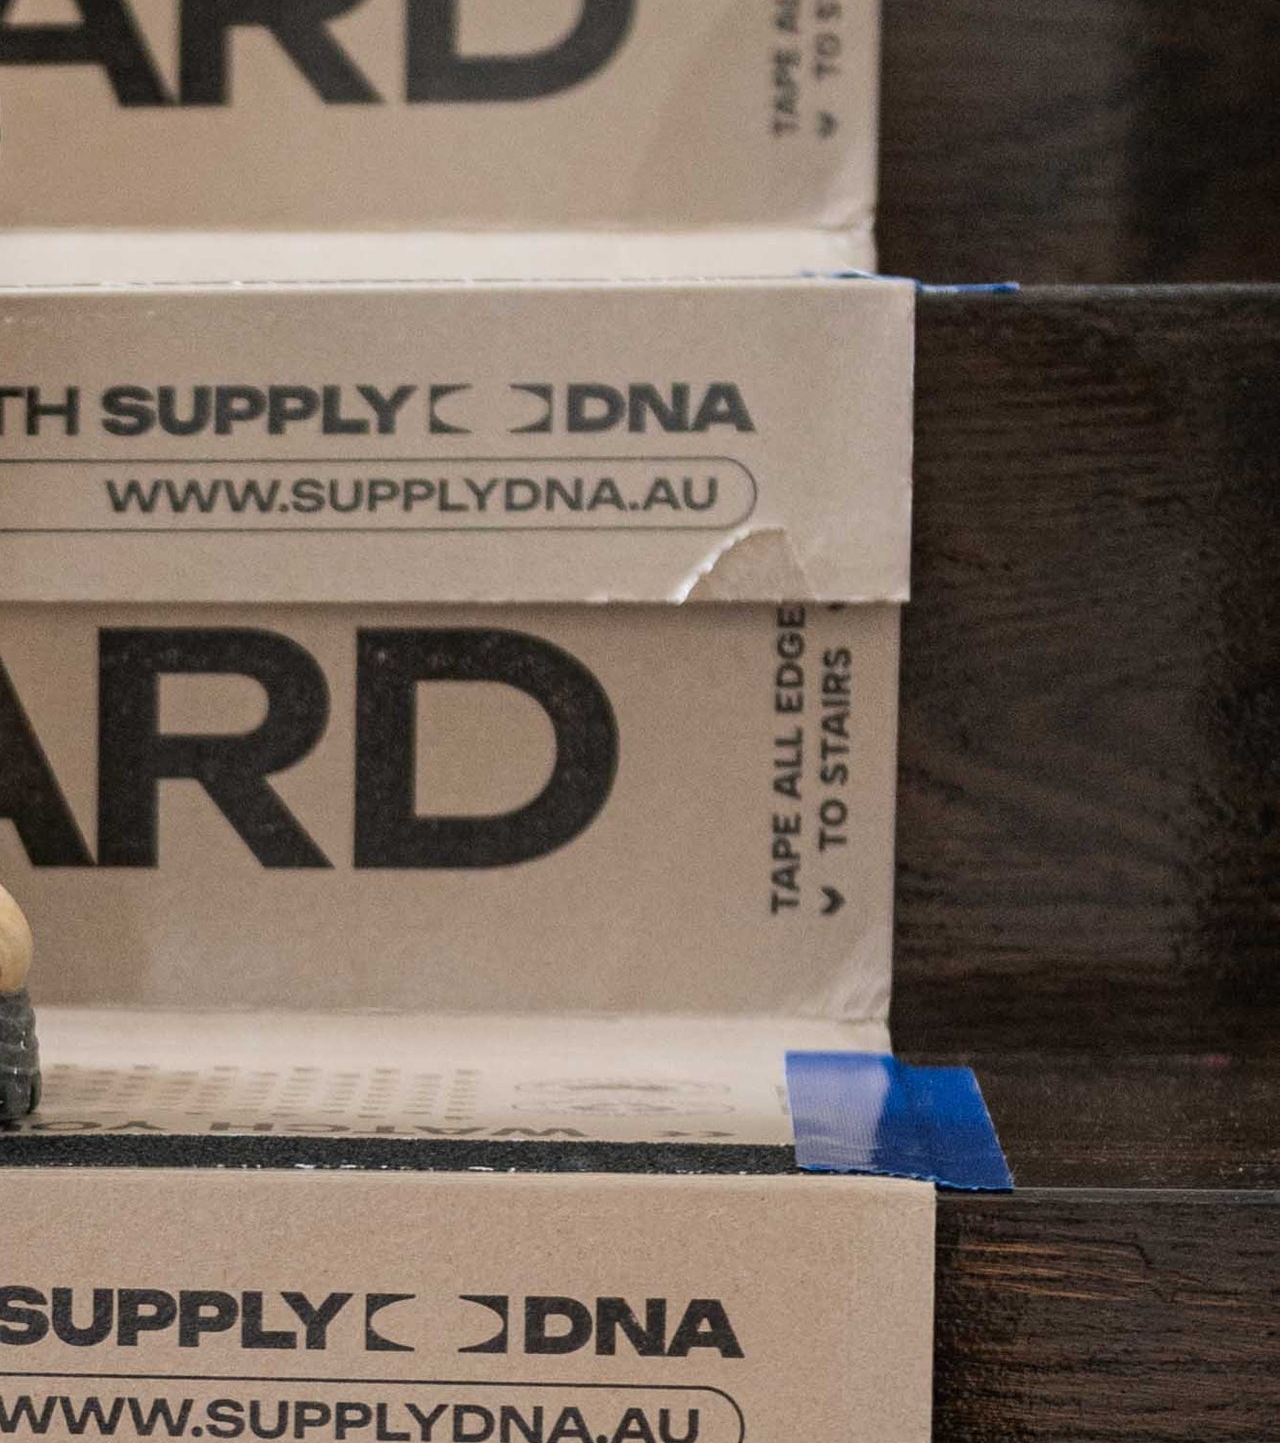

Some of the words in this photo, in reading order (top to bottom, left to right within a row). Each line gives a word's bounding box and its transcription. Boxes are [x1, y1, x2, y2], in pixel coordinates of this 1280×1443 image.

[101, 385, 415, 436] SUPPLY
[567, 383, 755, 433] DNA
[105, 478, 717, 513] WWW.SUPPLYDNA.AU
[773, 607, 807, 715] EDGE
[820, 648, 851, 785] STAIRS
[773, 728, 803, 800] ALL
[818, 799, 848, 852] TO
[771, 814, 801, 914] TAPE
[524, 1296, 744, 1358] DNA
